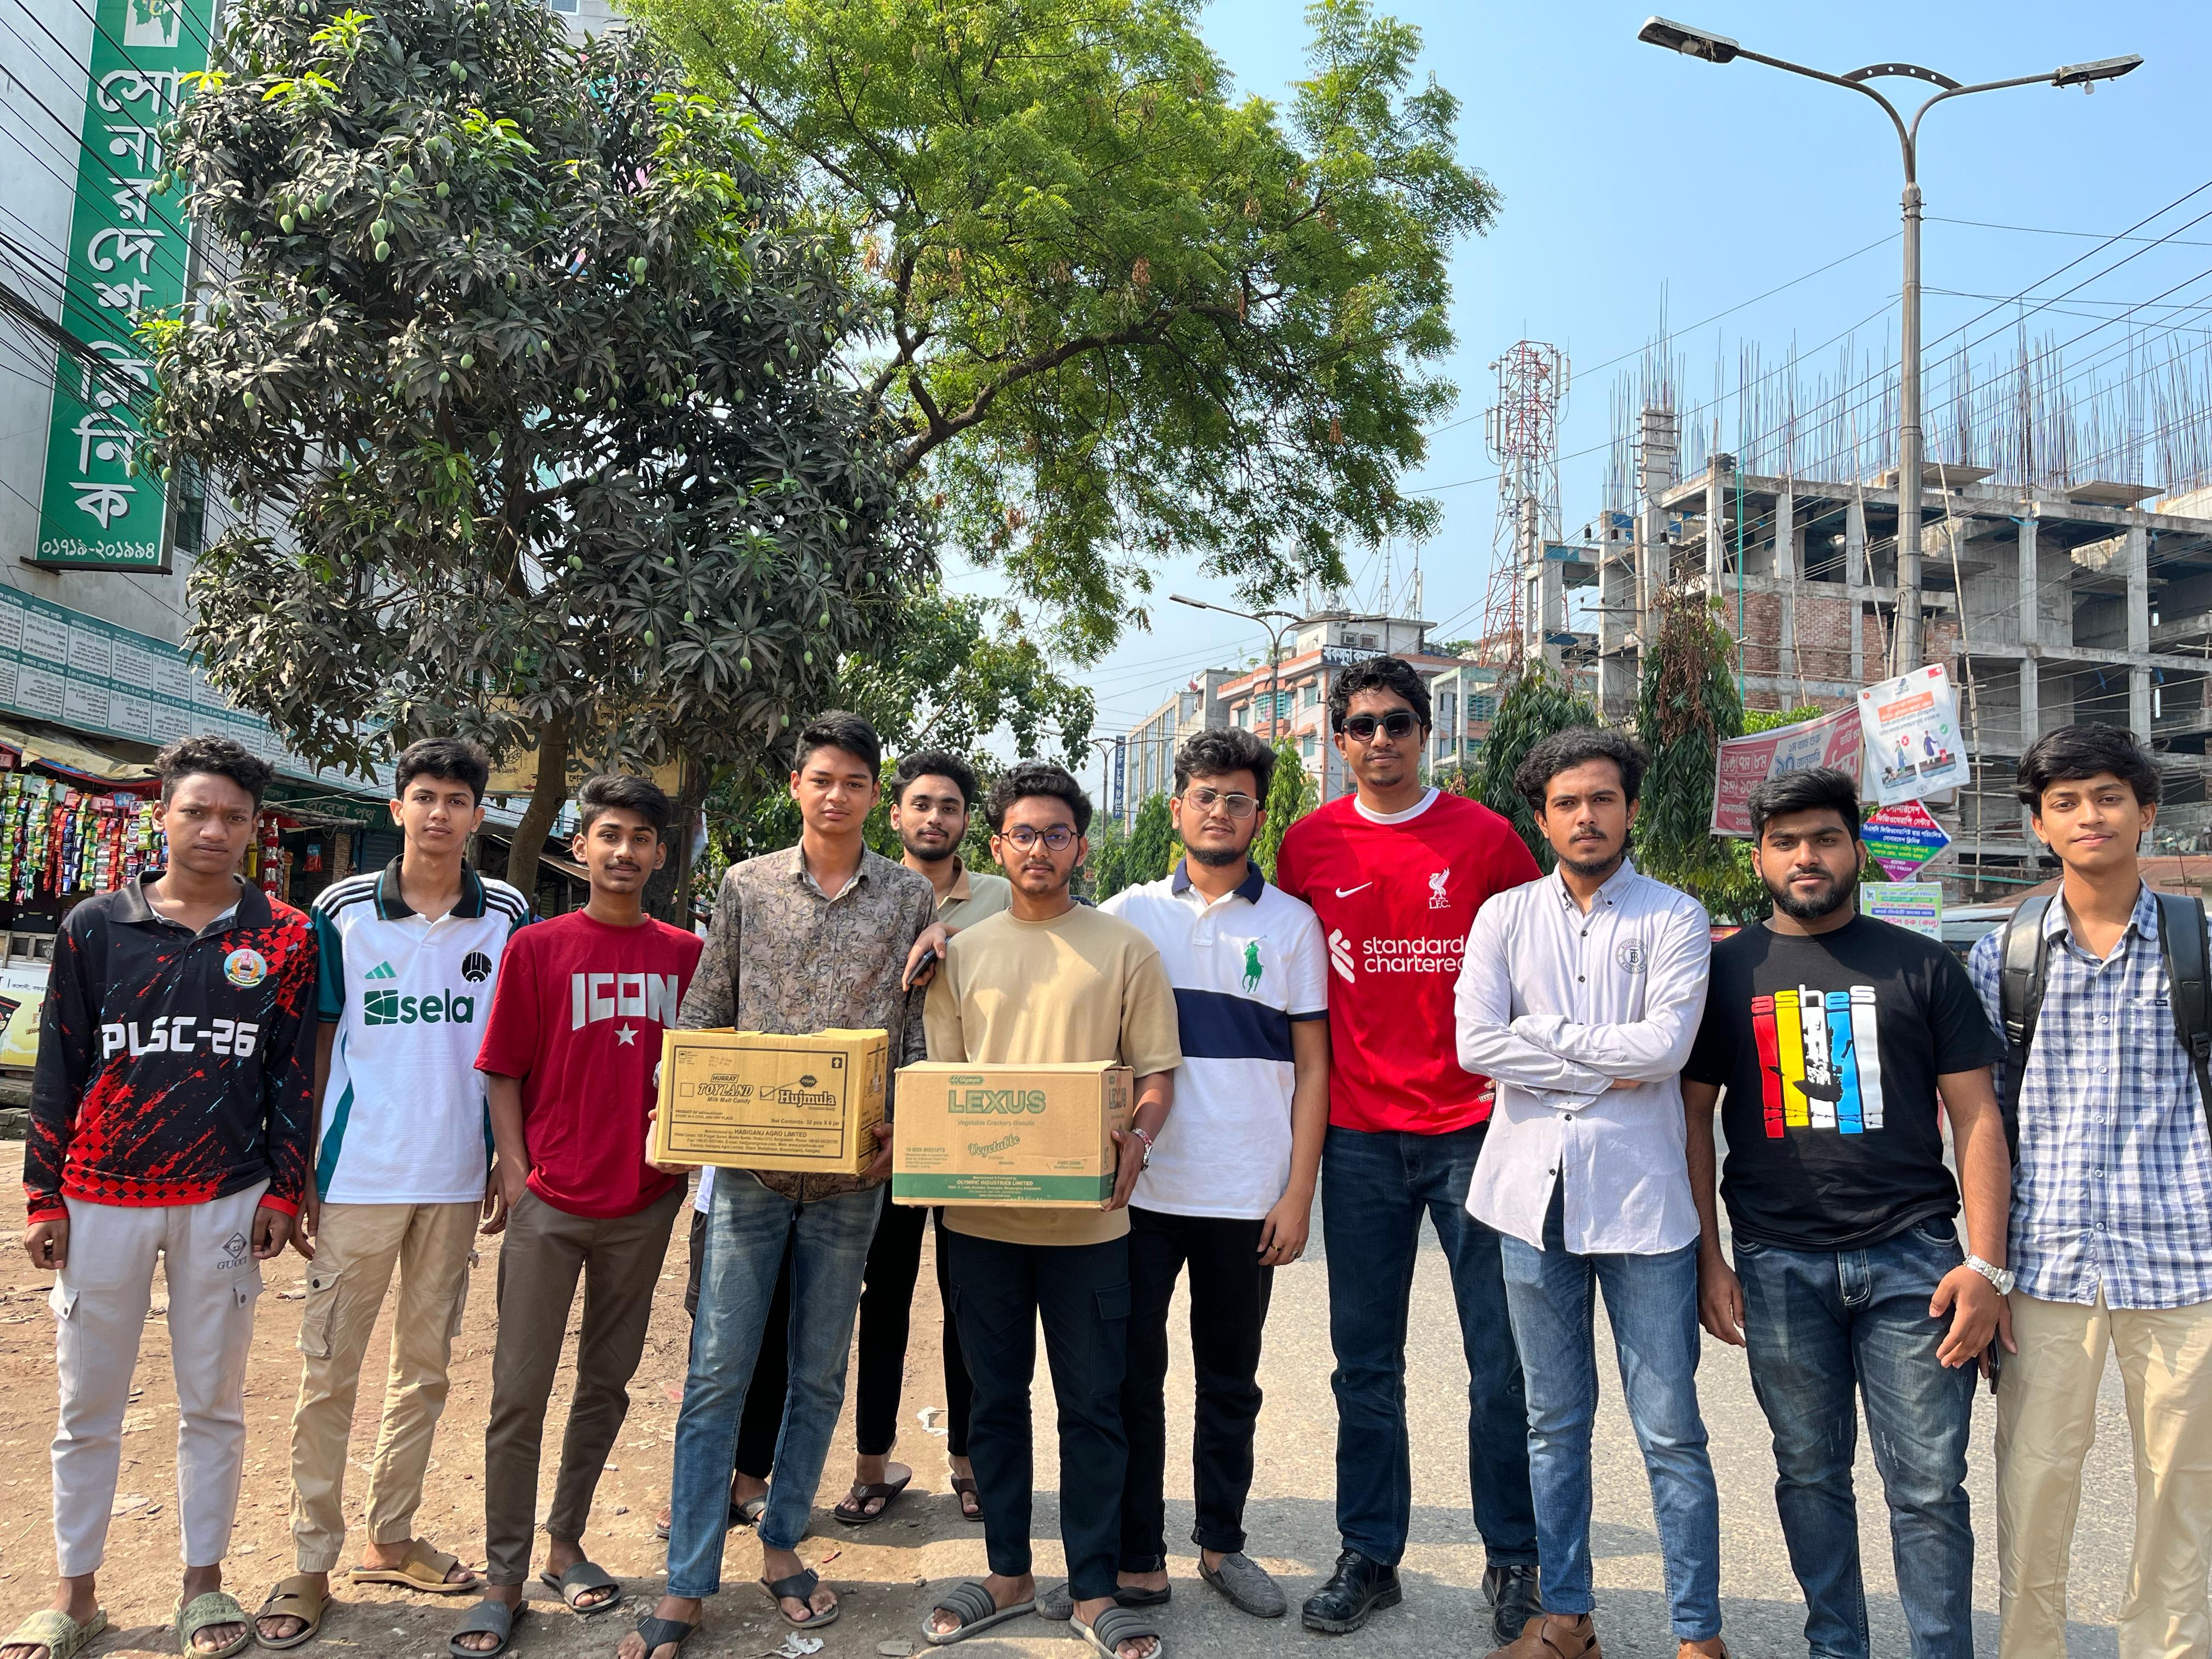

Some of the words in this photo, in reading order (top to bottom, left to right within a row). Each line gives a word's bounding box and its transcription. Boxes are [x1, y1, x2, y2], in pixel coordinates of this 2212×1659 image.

[42, 538, 155, 560] ০১৭১৯-২০১৯৯৪
[1739, 756, 1751, 770] ৭ম
[1754, 754, 1767, 769] ৮ম
[1722, 780, 1735, 793] ৯ম
[355, 808, 376, 822] পথ
[1363, 935, 1464, 955] standard
[400, 988, 474, 1024] sela
[572, 973, 679, 1031] ICON
[1751, 984, 1876, 1014] ashes
[101, 1017, 259, 1059] PLSC-26
[698, 1084, 754, 1097] TOYLAND
[778, 1090, 836, 1107] Hujmula
[949, 1090, 1046, 1114] LEXUS
[968, 1134, 1020, 1158] Vegetable
